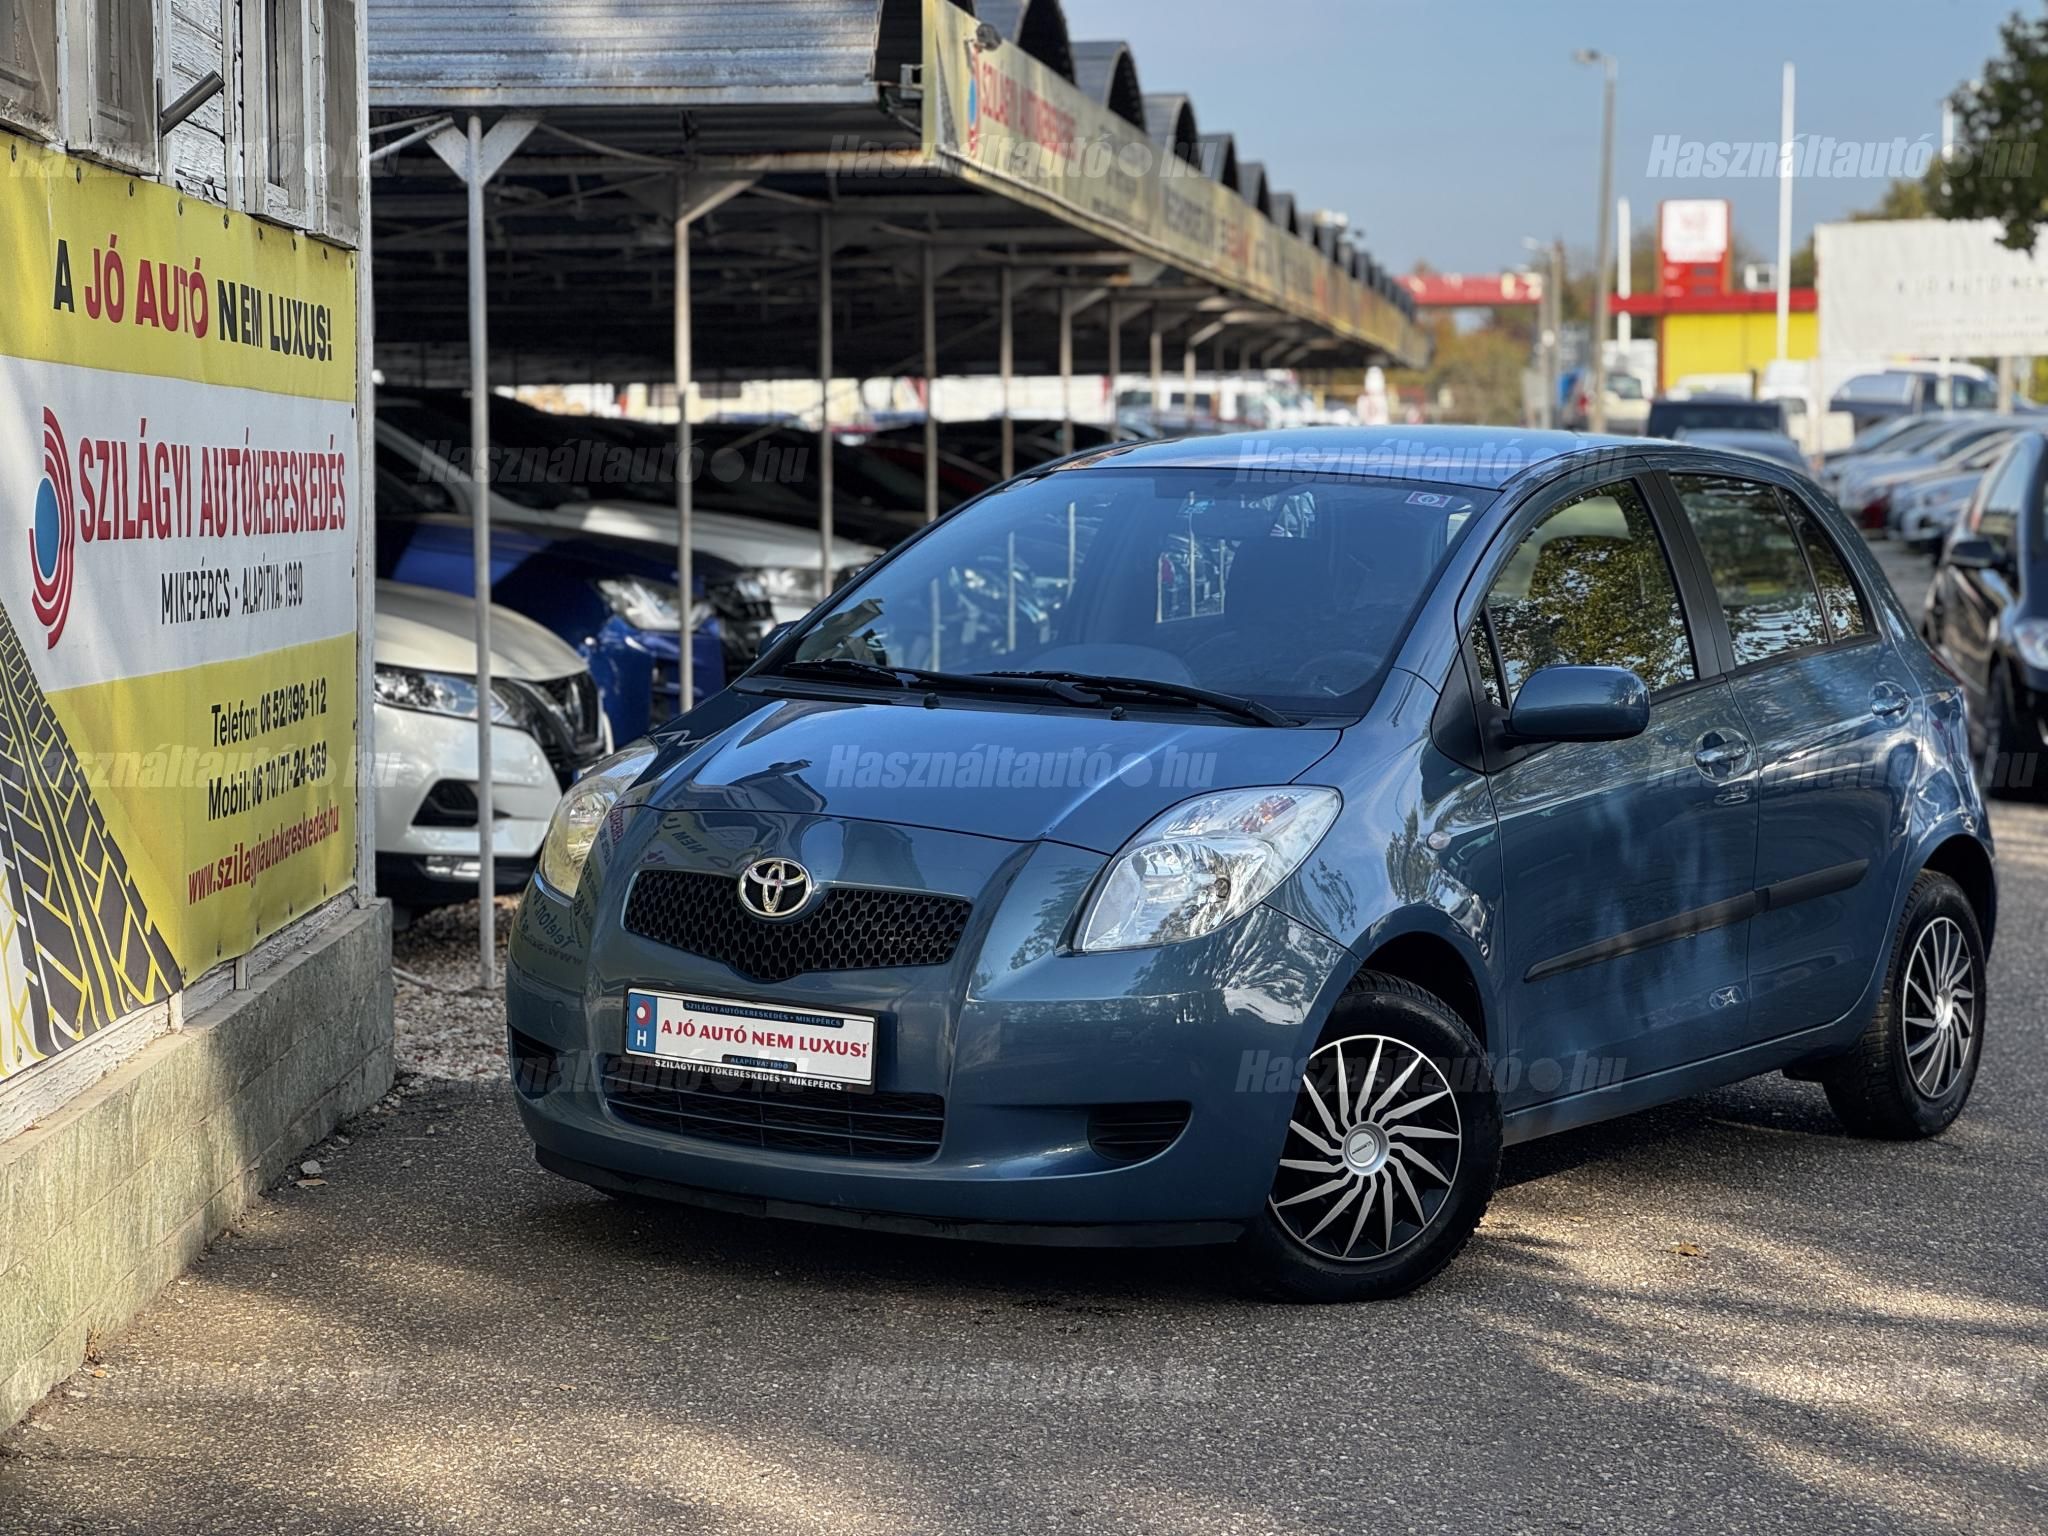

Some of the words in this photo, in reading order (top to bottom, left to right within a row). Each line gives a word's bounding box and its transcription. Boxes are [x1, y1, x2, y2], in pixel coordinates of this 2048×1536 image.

[53, 239, 75, 313] A
[84, 234, 125, 323] JÓ
[135, 257, 209, 339] AUTÓ
[217, 279, 263, 348] NEM
[268, 293, 333, 362] LUXUS!
[79, 418, 191, 543] SZILÁGYI
[199, 427, 346, 538] AUTÓKERESKEDÉS
[161, 556, 231, 625] MIKEPÉRCS
[242, 552, 283, 615] ALAPÍTVA:
[284, 561, 303, 608] 1990
[211, 699, 257, 748] Telefon:
[260, 693, 271, 734] 06
[273, 677, 327, 729] 52/398-112
[208, 770, 251, 821] Mobil:
[252, 765, 263, 807] 06
[266, 740, 327, 801] 70/77-24-369
[188, 799, 339, 905] www.szilagyiautokereskedes.hu
[636, 1030, 647, 1048] H
[661, 1020, 672, 1034] A
[676, 1019, 695, 1037] JÓ
[699, 1024, 747, 1044] AUTÓ
[752, 1031, 793, 1050] NEM
[799, 1036, 868, 1058] LUXUS!
[685, 1002, 718, 1014] SZILÁGYI
